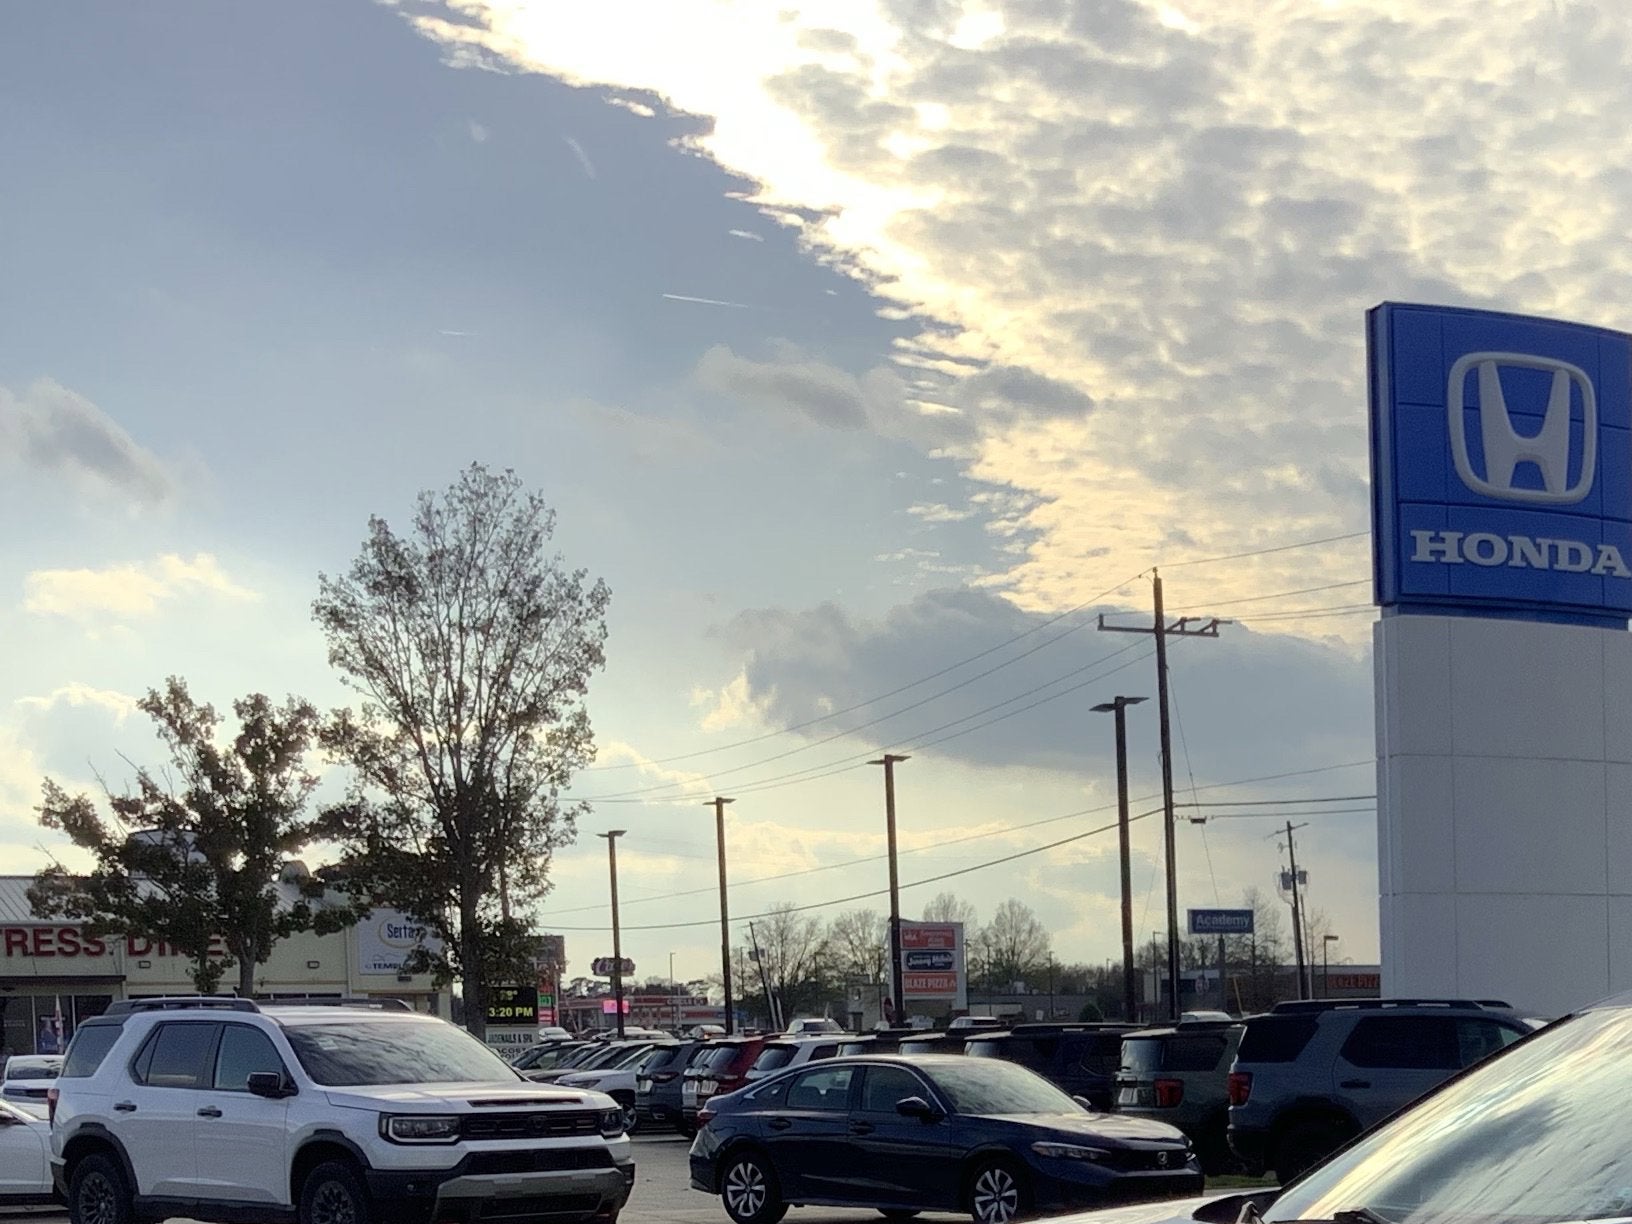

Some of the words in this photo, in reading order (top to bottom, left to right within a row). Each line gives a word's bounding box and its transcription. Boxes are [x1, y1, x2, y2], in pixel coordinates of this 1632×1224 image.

[1410, 530, 1632, 578] HONDA
[1196, 914, 1250, 928] Academy
[387, 923, 417, 939] Serta
[0, 928, 106, 957] RESS
[373, 962, 402, 970] TEMP
[488, 1007, 513, 1018] 3:20
[515, 1007, 534, 1018] PM
